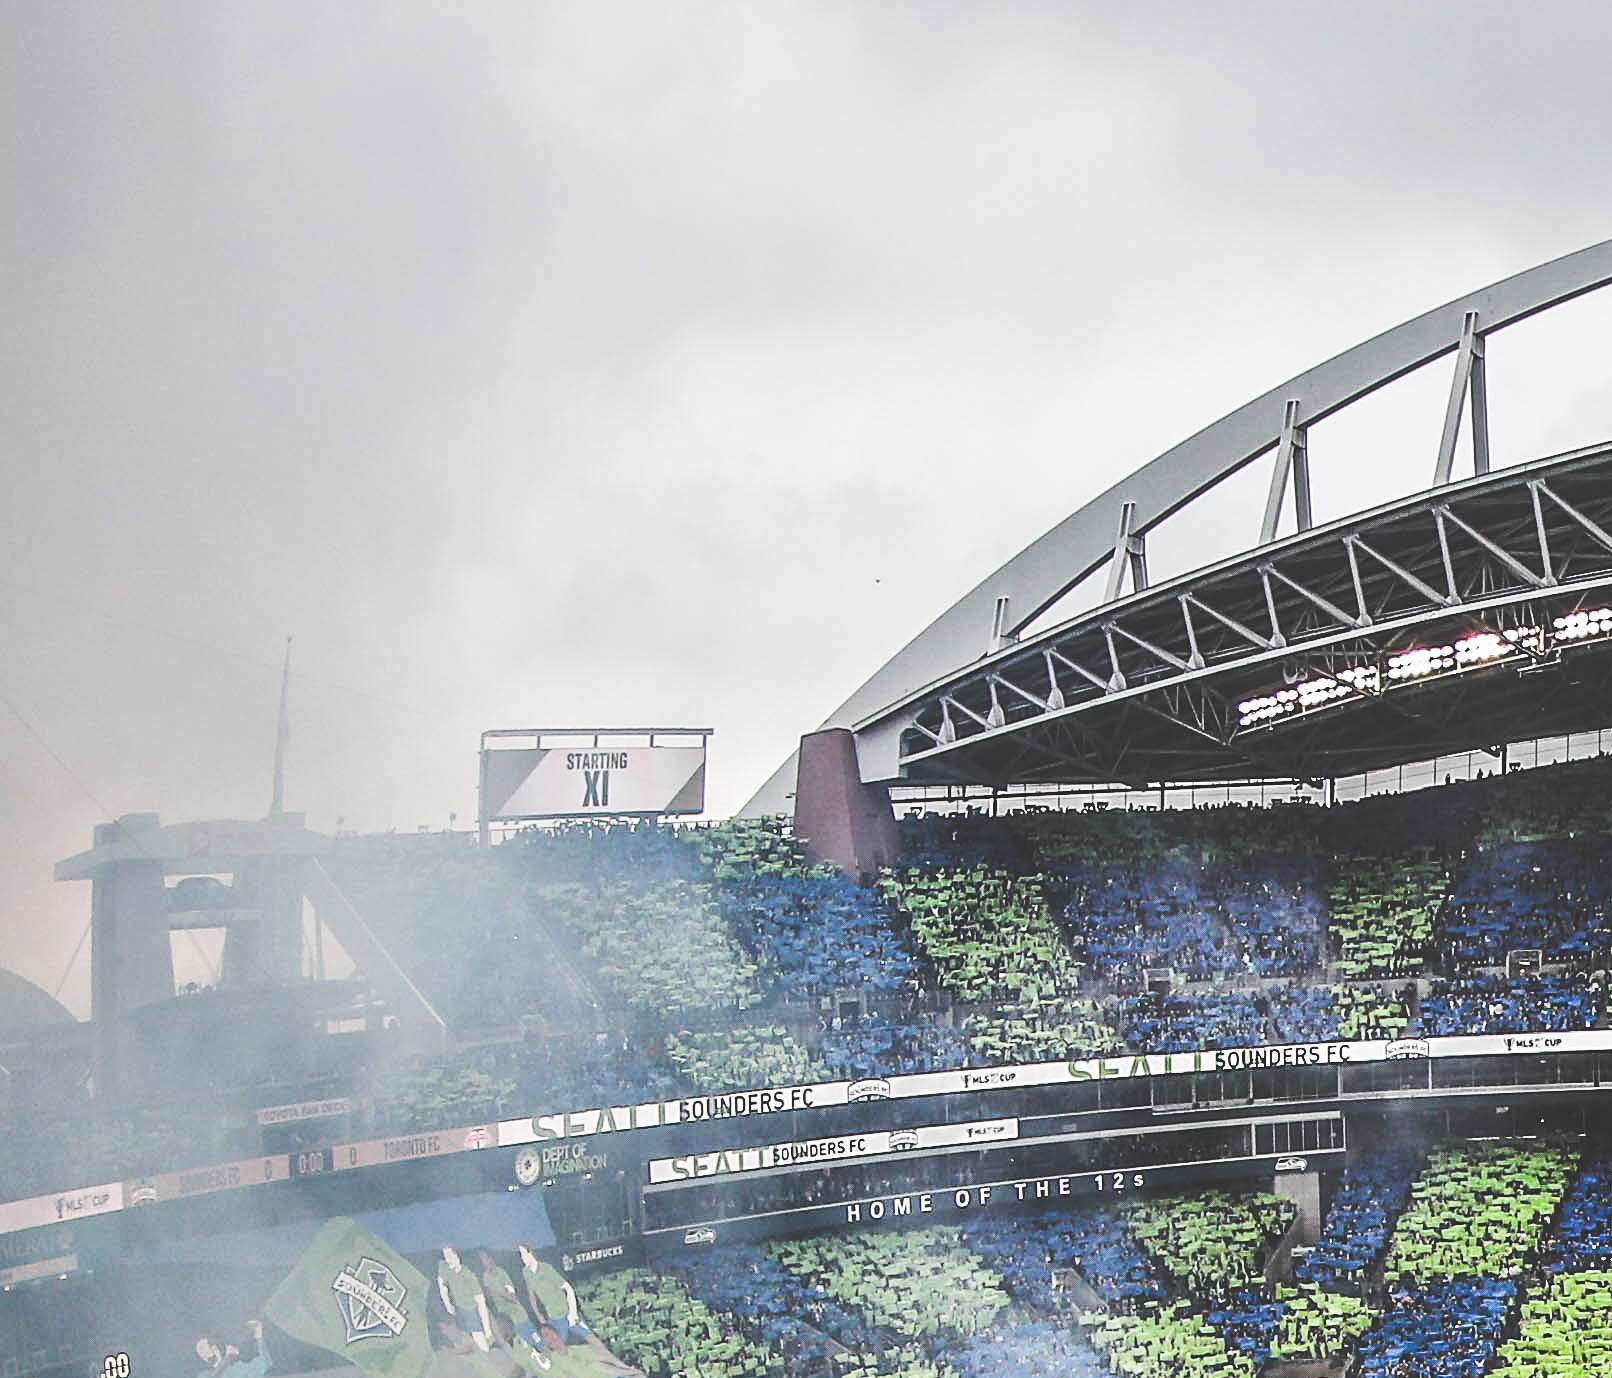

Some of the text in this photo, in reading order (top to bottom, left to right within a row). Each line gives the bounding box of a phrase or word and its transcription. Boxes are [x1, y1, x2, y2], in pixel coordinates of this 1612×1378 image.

[567, 752, 628, 770] STARTING
[582, 770, 609, 807] XI
[1544, 1038, 1562, 1047] CUP
[1215, 1044, 1350, 1071] SOUNDERS FC
[1000, 1072, 1016, 1082] CUP
[680, 1088, 814, 1121] SOUNDERS FC
[543, 1143, 587, 1162] DEPT OF
[773, 1141, 845, 1164] SOUNDERS
[849, 1139, 866, 1153] FC
[847, 1173, 1144, 1223] HOME OF THE 12s
[575, 1245, 624, 1264] STARBUCKS
